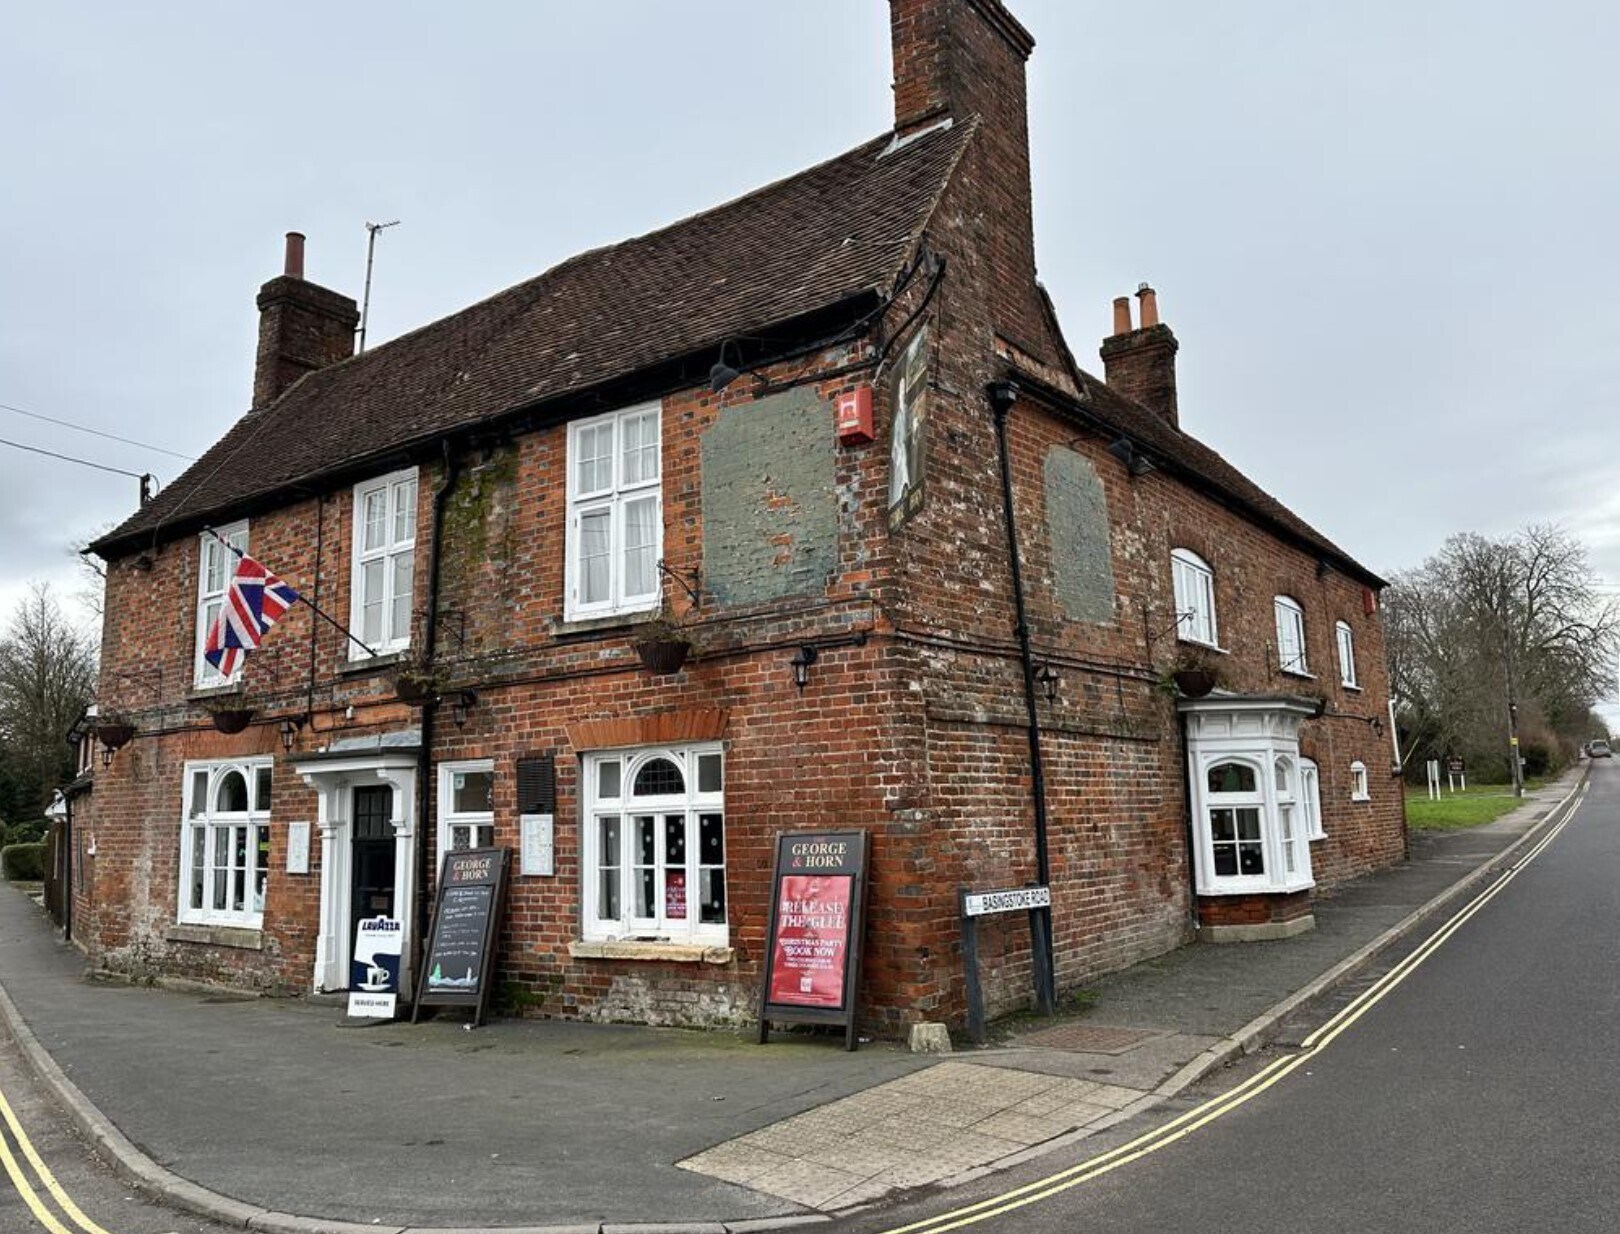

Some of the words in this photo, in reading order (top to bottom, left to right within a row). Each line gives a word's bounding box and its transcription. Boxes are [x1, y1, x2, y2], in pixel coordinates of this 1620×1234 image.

[792, 841, 847, 855] GEORGE
[453, 857, 492, 870] GEORGE
[792, 856, 802, 868] &
[806, 855, 844, 867] HORN
[461, 869, 488, 880] HORN
[982, 891, 1030, 911] BASINGSTOKE
[814, 947, 835, 956] NOW
